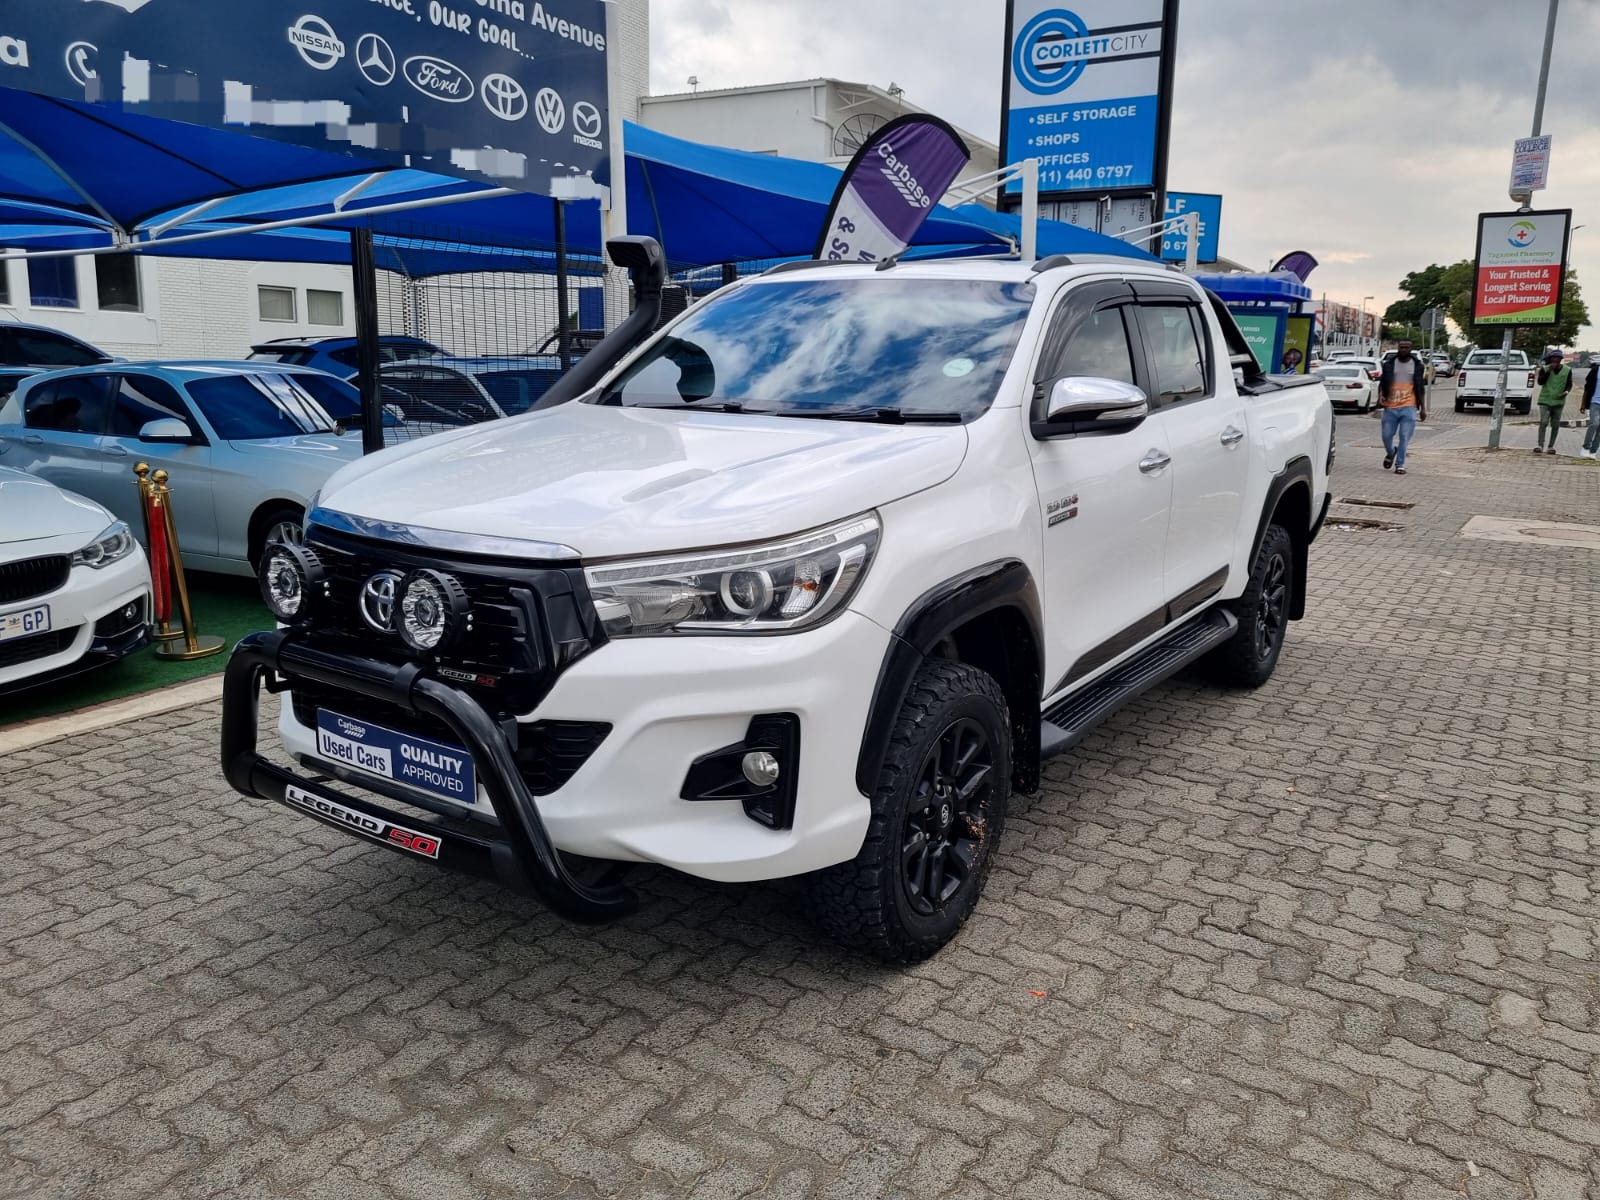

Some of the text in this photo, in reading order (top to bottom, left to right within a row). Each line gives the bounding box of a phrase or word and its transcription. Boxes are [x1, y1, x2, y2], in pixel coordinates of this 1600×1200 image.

[429, 0, 471, 35] OUR
[531, 2, 606, 52] Avenue
[292, 31, 342, 53] NISSAN
[417, 62, 461, 95] Ford
[1037, 105, 1137, 125] SELF STORAGE
[573, 134, 603, 150] mazda
[1035, 132, 1080, 146] SHOPS
[1514, 141, 1549, 153] COLLEGE
[877, 142, 931, 208] Carbase
[1037, 165, 1133, 185] 11) 440 6797
[1489, 269, 1549, 280] Your Trusted &
[1484, 281, 1552, 293] Longest Serving
[1483, 294, 1550, 305] Local Pharmacy
[23, 610, 44, 632] GP
[337, 718, 366, 735] Carbase
[322, 735, 386, 772] Used Cars
[400, 743, 463, 775] QUALITY
[402, 764, 464, 793] APPROVED
[288, 789, 437, 855] LEGEND 50
